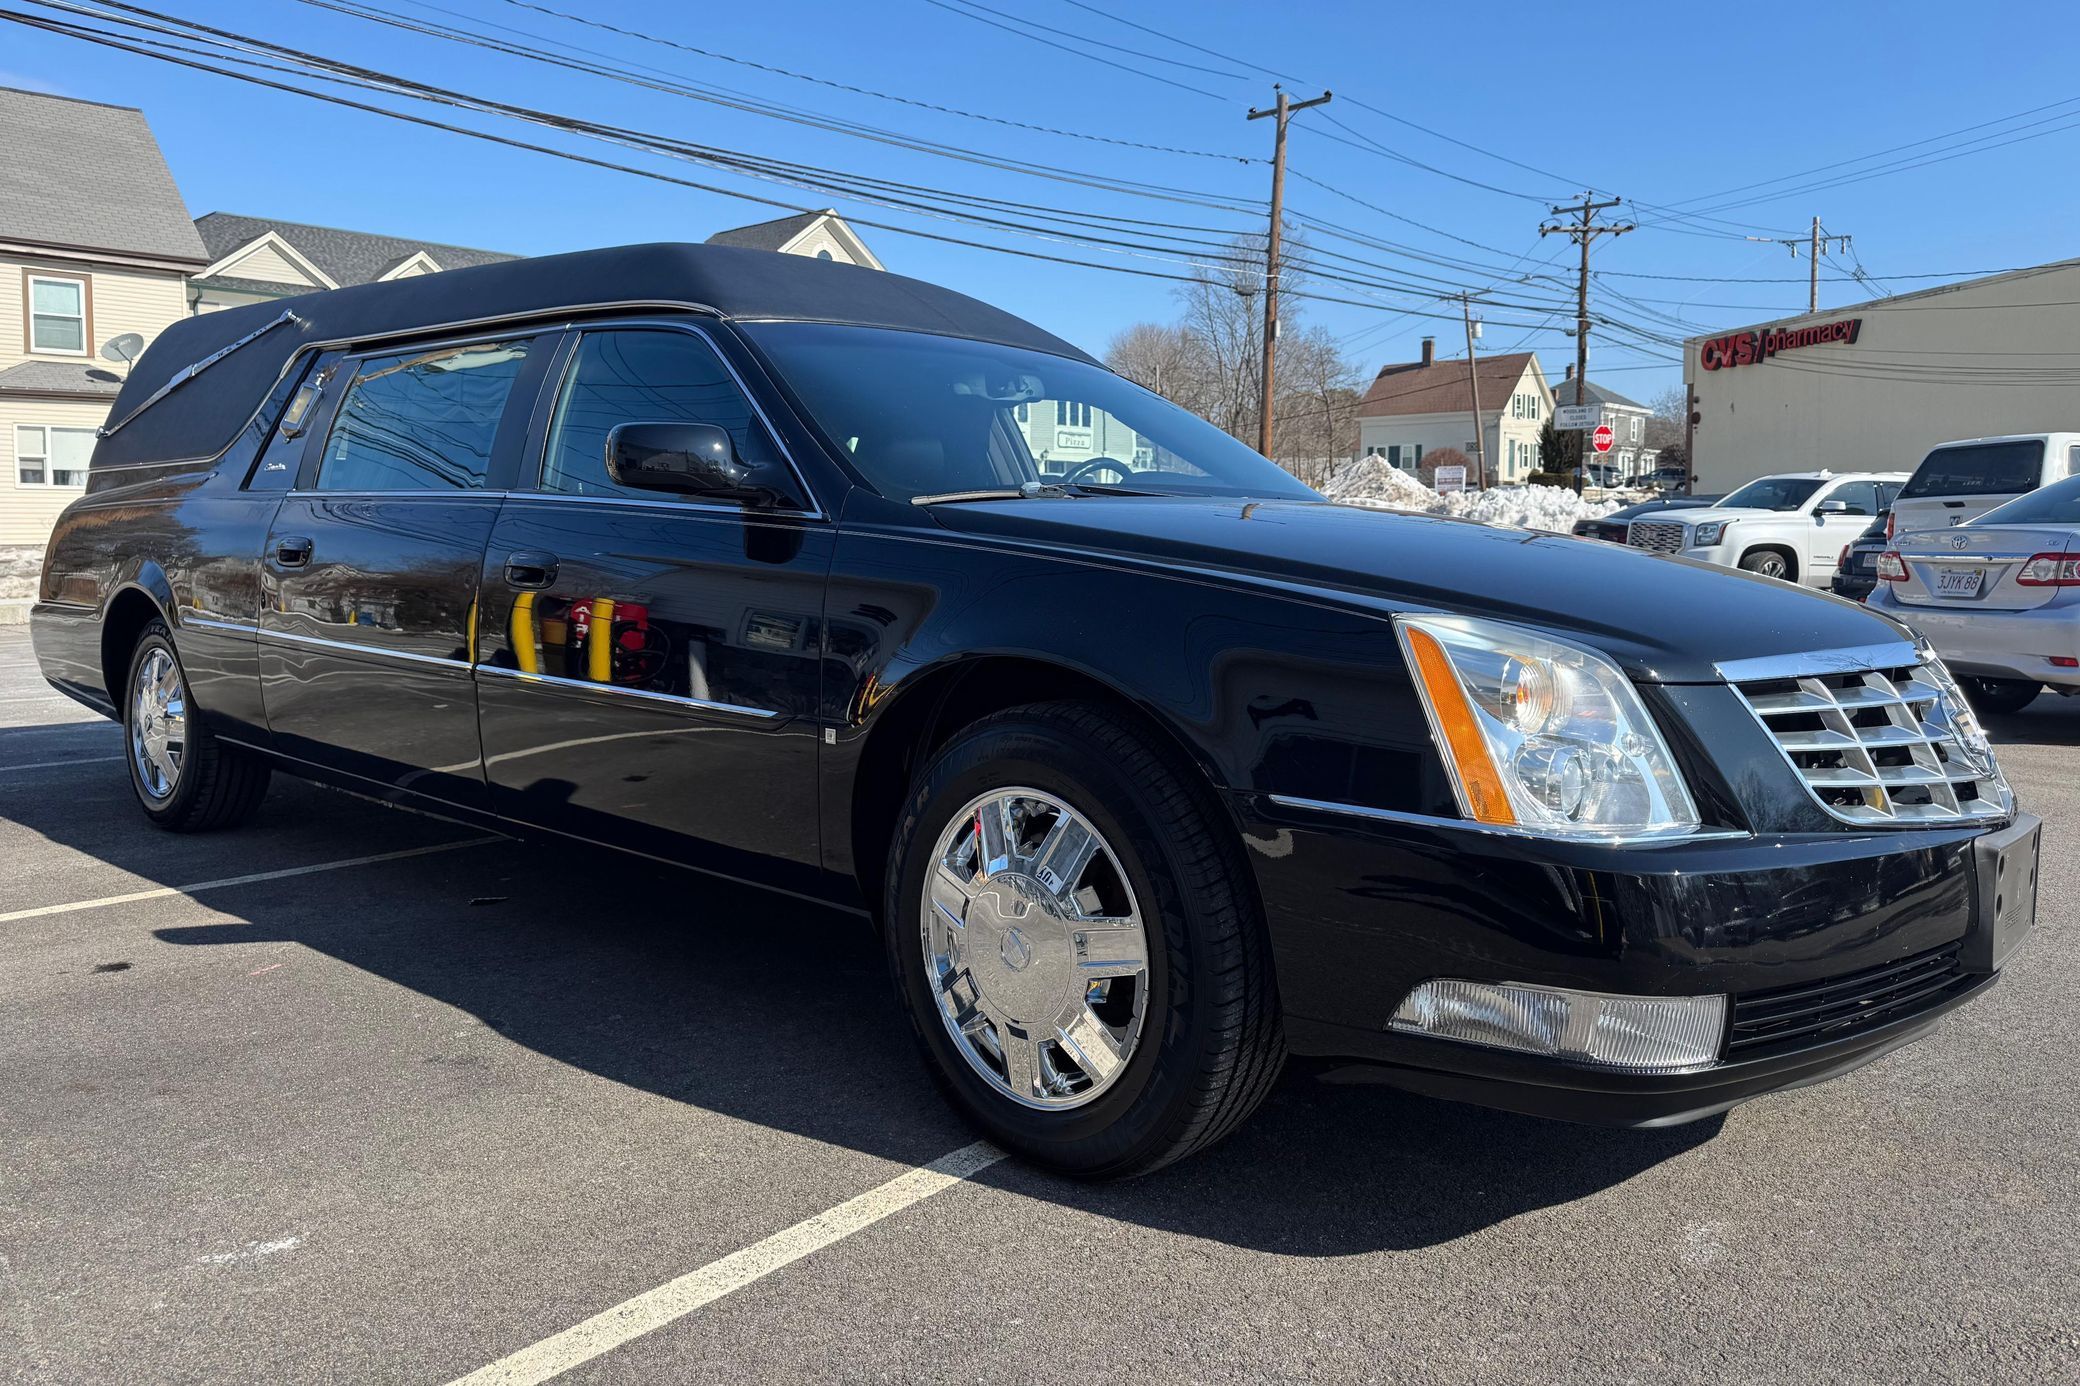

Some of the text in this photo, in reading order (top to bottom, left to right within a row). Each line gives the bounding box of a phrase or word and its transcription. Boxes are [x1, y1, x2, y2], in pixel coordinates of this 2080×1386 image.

[1065, 437, 1085, 446] Pizza
[1594, 433, 1612, 444] STOP
[1937, 575, 1980, 590] 3JYK 88
